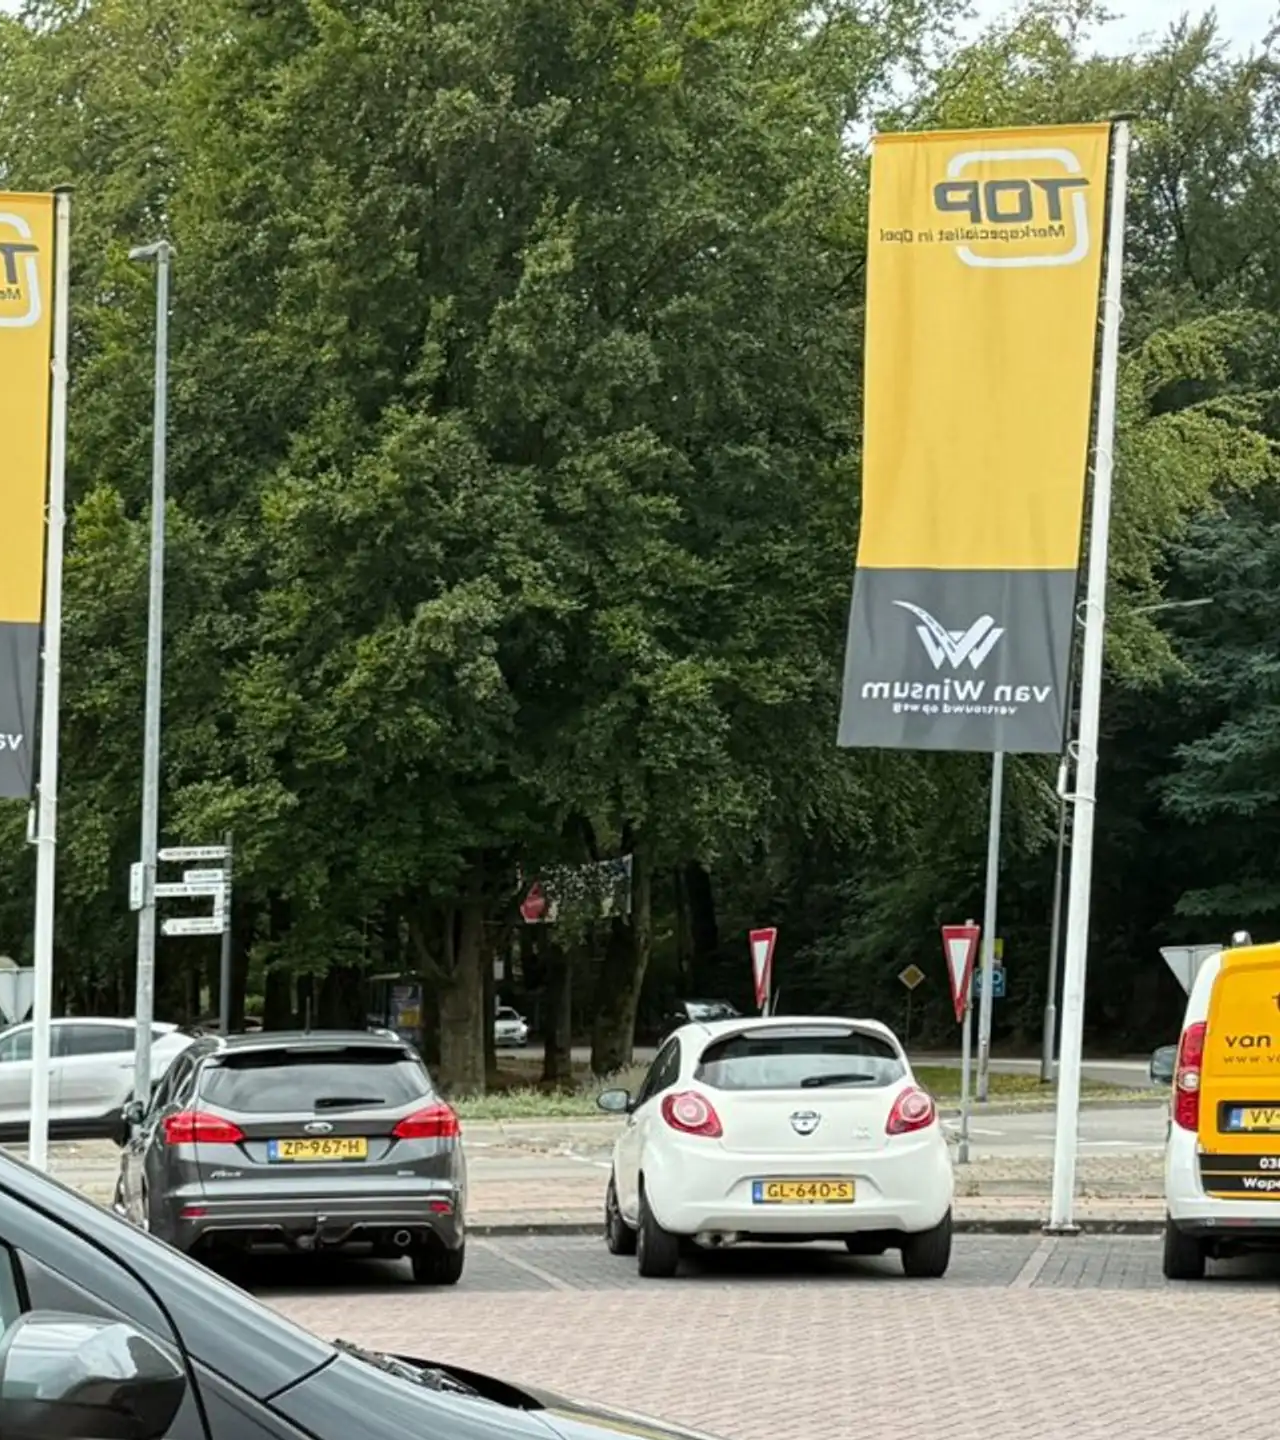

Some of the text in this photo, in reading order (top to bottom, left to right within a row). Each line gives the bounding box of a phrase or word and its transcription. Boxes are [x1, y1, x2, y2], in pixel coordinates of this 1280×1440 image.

[1224, 1034, 1271, 1048] van
[284, 1138, 360, 1155] ZP-967-H
[767, 1183, 848, 1197] GL-640-S
